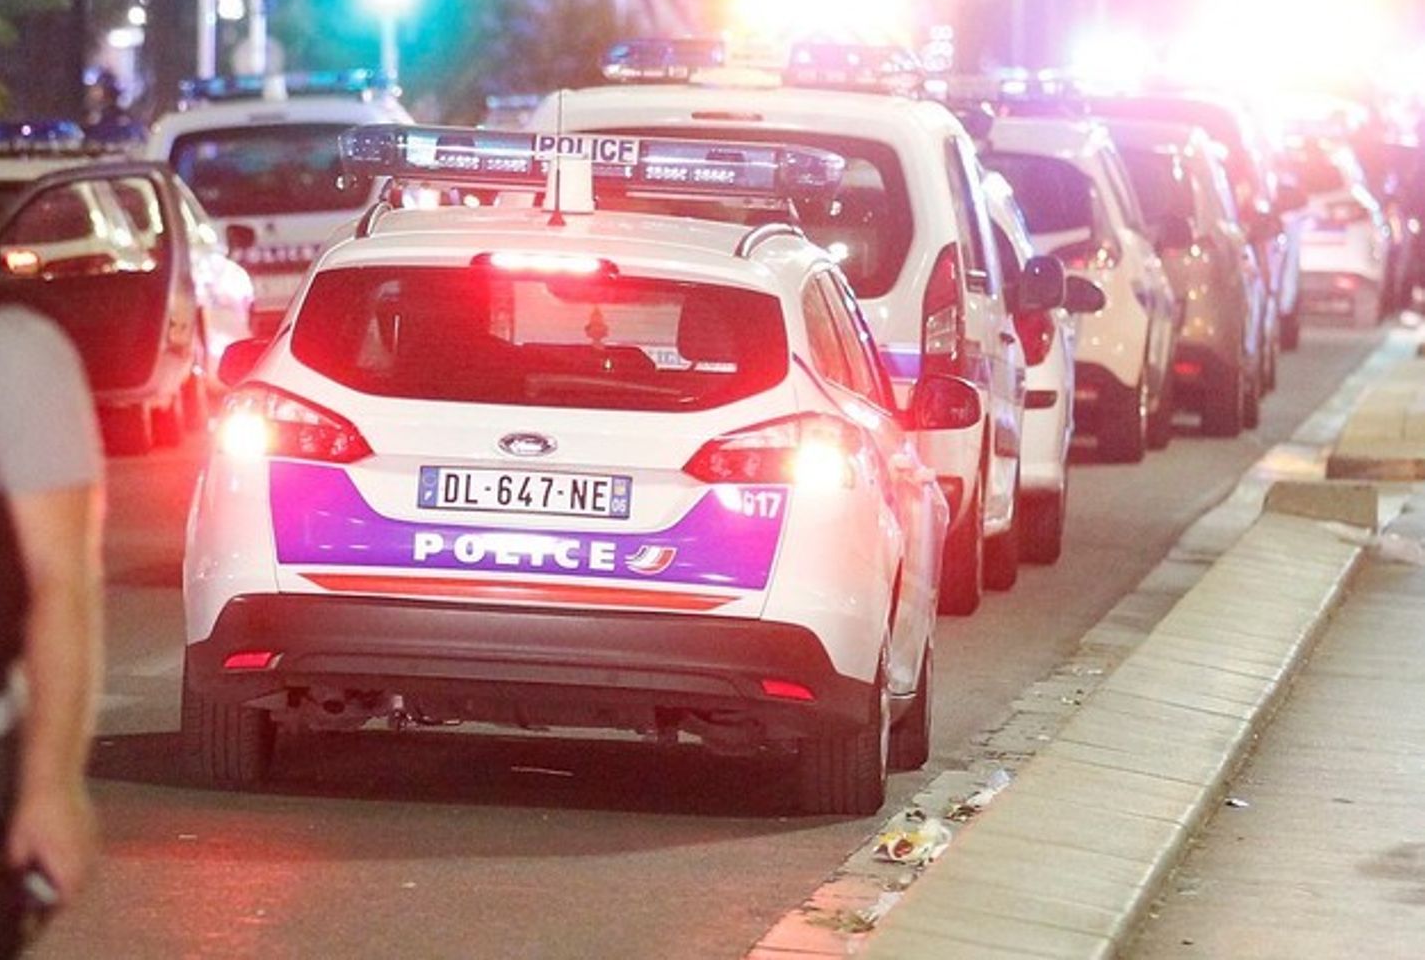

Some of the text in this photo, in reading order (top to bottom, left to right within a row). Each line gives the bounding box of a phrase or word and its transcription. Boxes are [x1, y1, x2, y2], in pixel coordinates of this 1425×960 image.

[539, 136, 635, 162] POLICE
[443, 473, 608, 512] DL-647-NE
[412, 532, 617, 571] POLICE
